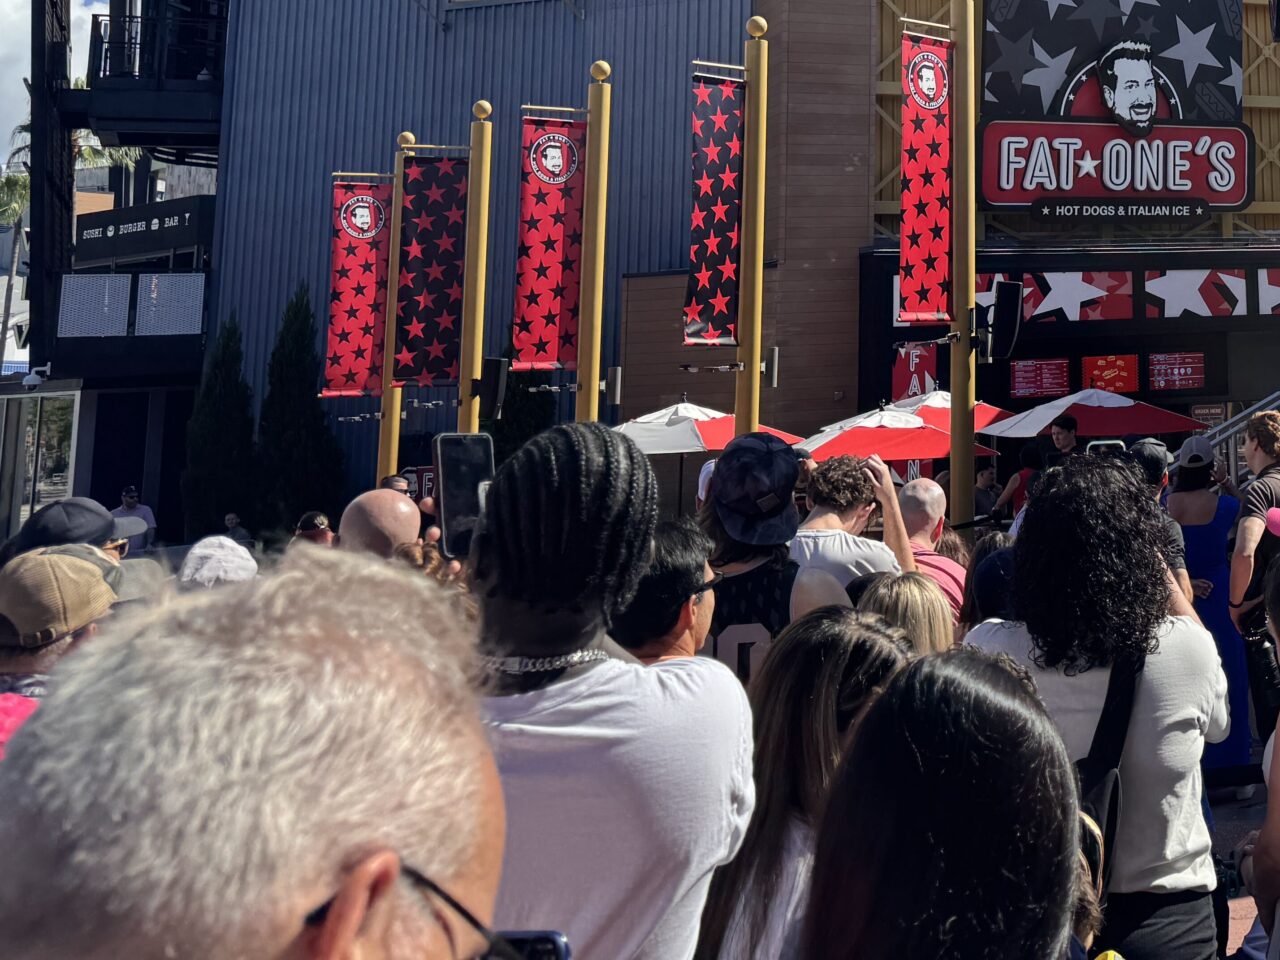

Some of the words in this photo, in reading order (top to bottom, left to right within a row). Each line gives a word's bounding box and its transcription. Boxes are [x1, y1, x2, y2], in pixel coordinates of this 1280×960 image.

[999, 136, 1083, 191] FAT
[1102, 136, 1236, 192] ONE'S
[82, 227, 103, 240] SUSHI
[118, 221, 147, 235] BURGER
[163, 215, 179, 228] BAR
[1055, 205, 1081, 217] HOT
[1082, 205, 1116, 217] DOGS
[1117, 205, 1126, 216] &
[1127, 205, 1171, 217] ITALIAN
[1171, 205, 1191, 217] ICE
[908, 349, 922, 396] FA
